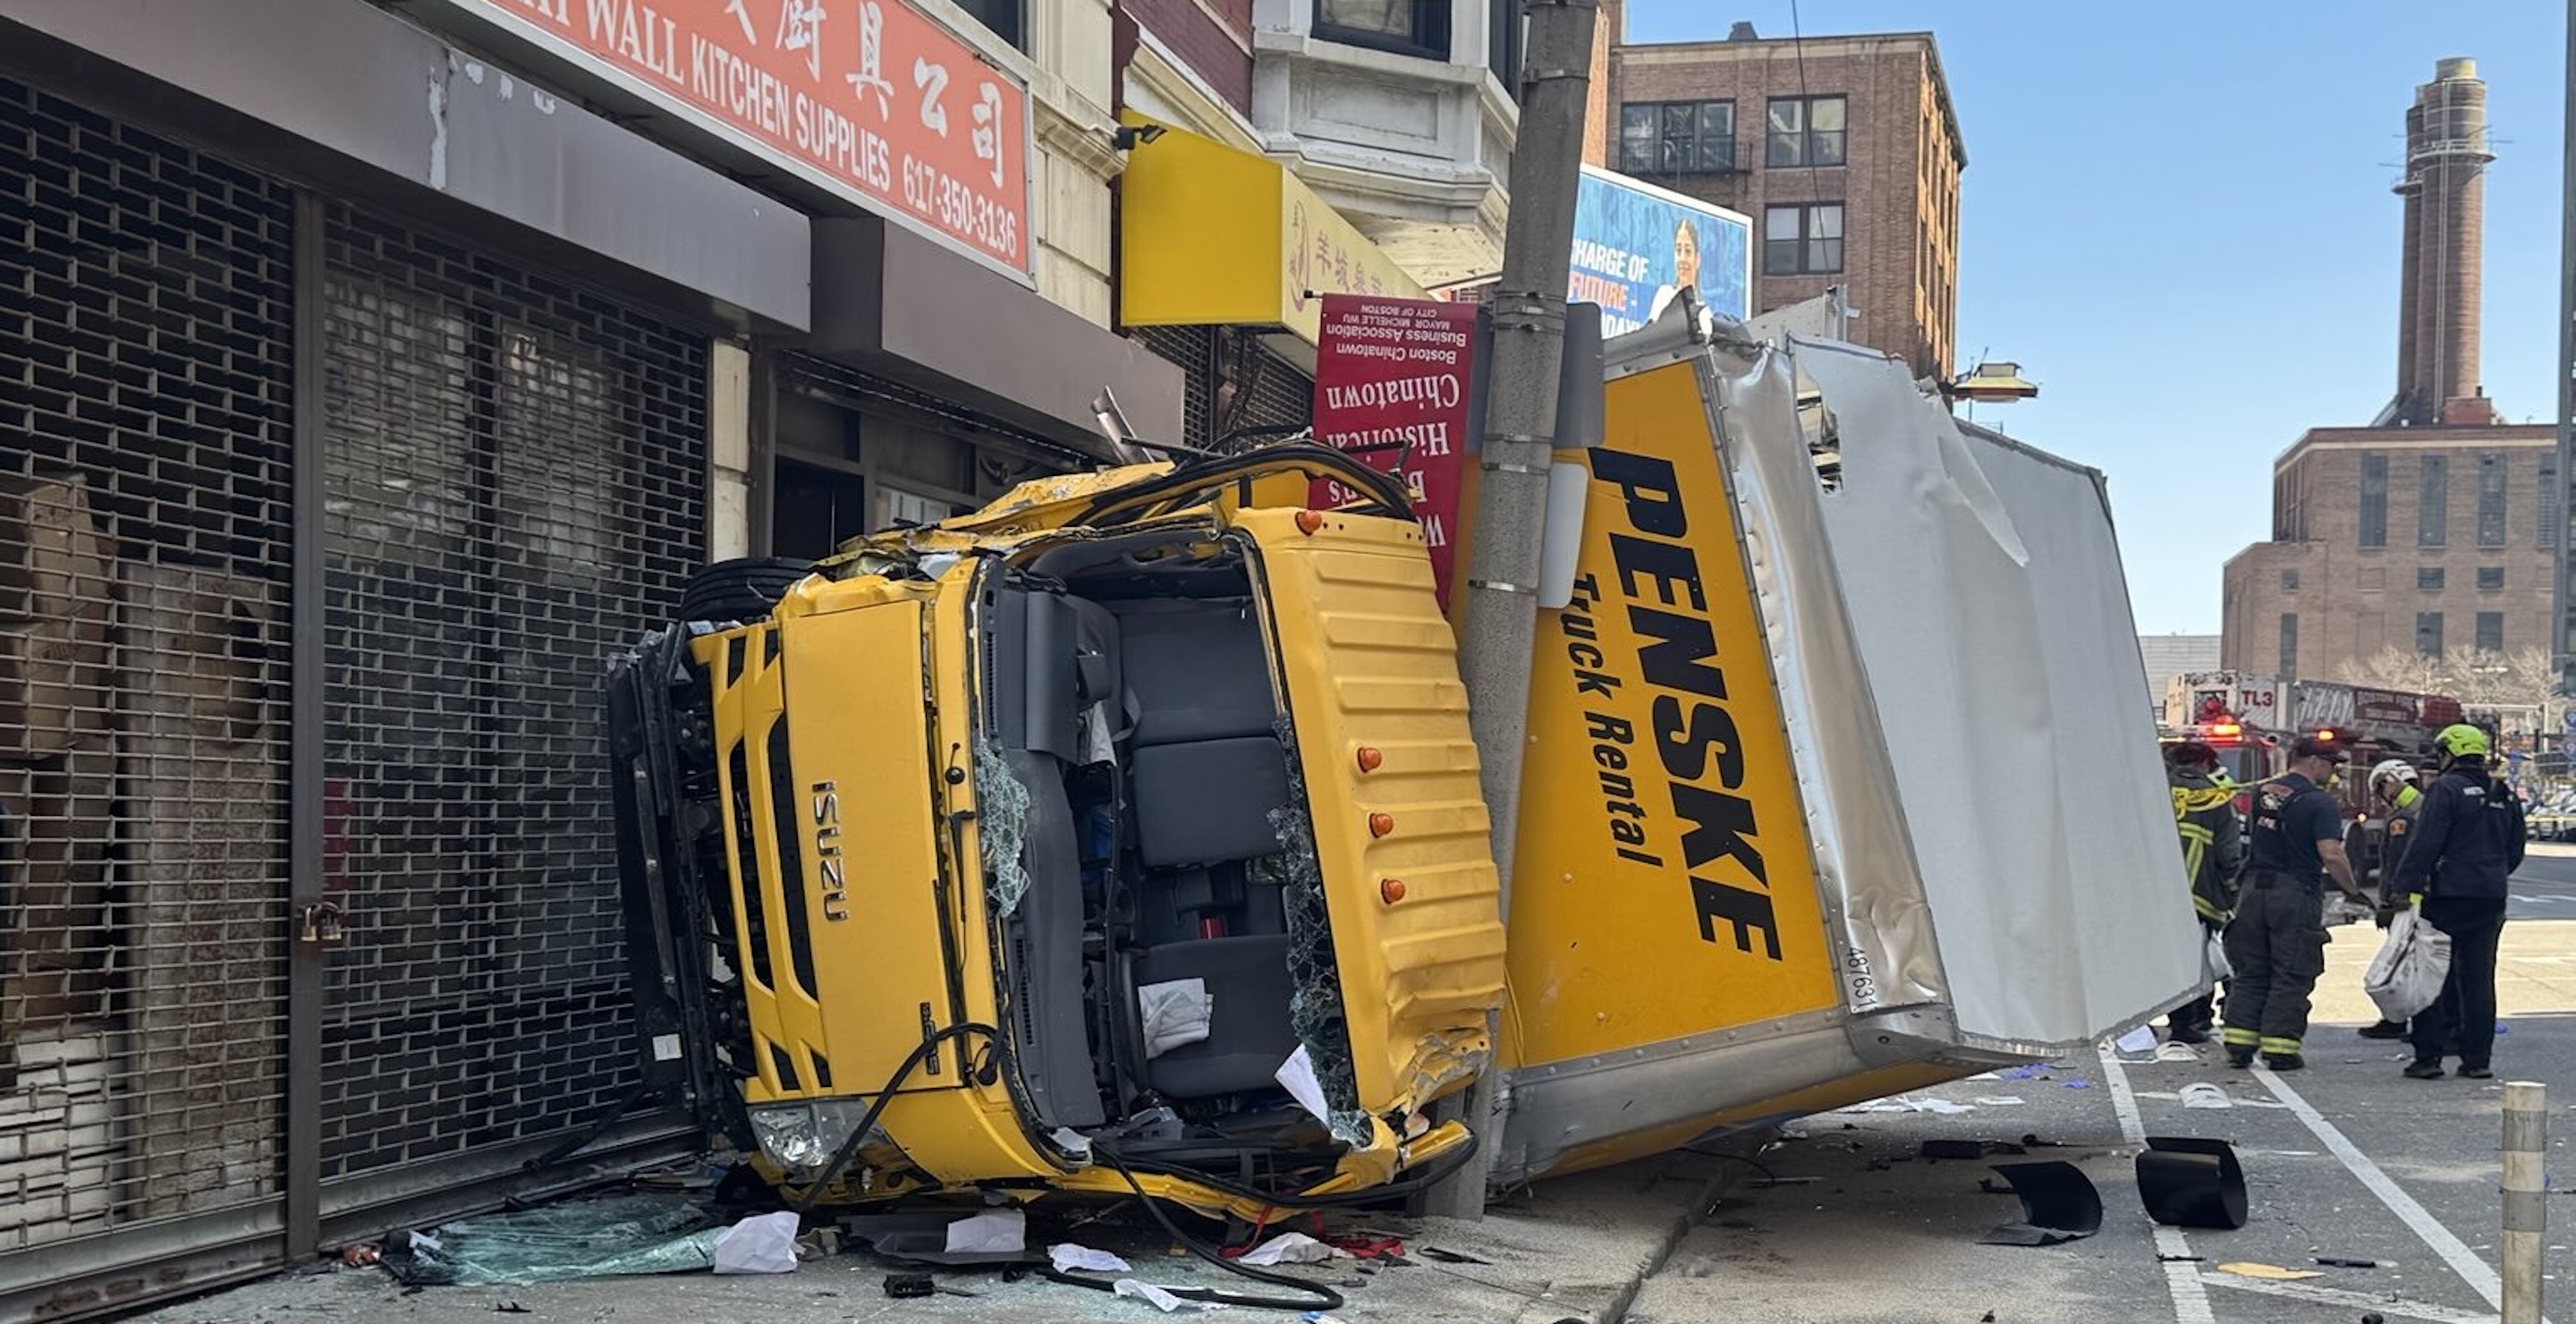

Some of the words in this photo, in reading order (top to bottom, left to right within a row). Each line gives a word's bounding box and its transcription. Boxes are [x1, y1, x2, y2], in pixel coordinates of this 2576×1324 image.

[587, 0, 684, 85] WALL
[691, 33, 790, 139] KITCHEN
[795, 91, 891, 192] SUPPLIES
[902, 153, 1017, 259] 617-350-3136
[1628, 253, 1649, 283] OF
[1569, 270, 1630, 310] FUTURE
[1343, 313, 1360, 324] WU
[1360, 304, 1400, 316] BOSTON
[1401, 307, 1415, 317] OF
[1416, 308, 1437, 318] CITY
[1361, 315, 1411, 327] MICHELLE
[1416, 319, 1451, 330] MAYOR
[1326, 323, 1404, 343] Association
[1405, 331, 1467, 347] Business
[1336, 342, 1406, 361] Chinatown
[1409, 348, 1457, 365] Boston
[1326, 373, 1460, 410] Chinatown
[1559, 571, 1622, 700] Truck
[1587, 447, 1784, 962] PENSKE
[2241, 691, 2275, 708] TL3
[1584, 710, 1665, 868] Rental
[811, 779, 848, 922] ISUZU
[1846, 946, 1877, 1008] 487631
